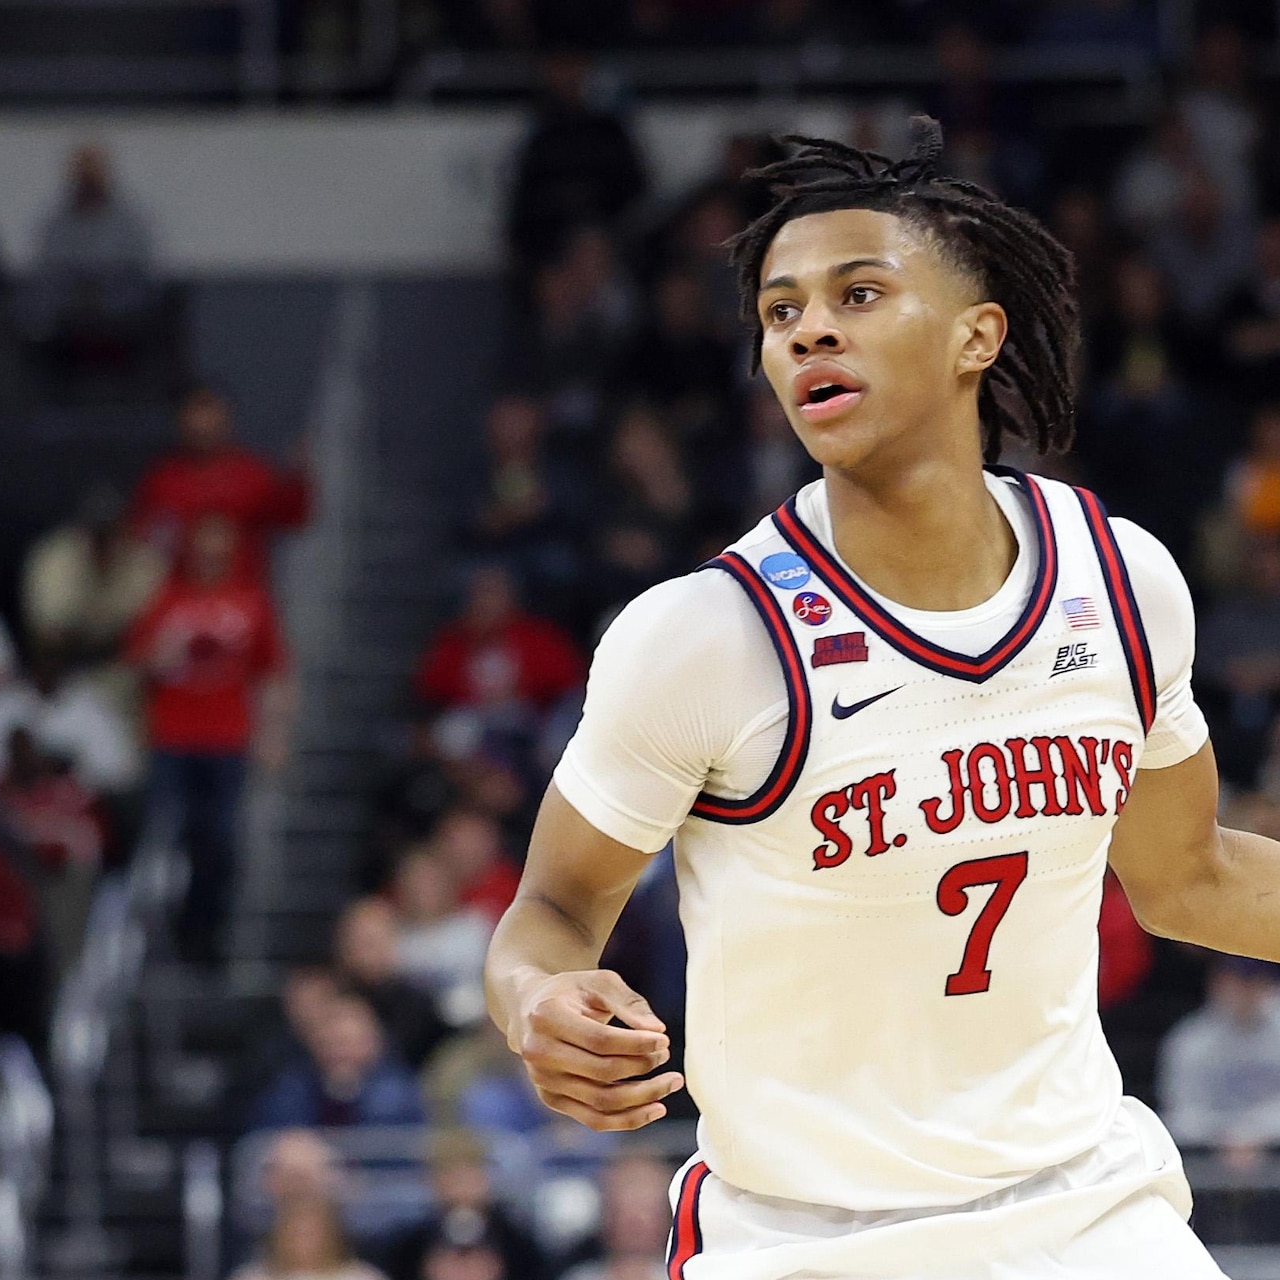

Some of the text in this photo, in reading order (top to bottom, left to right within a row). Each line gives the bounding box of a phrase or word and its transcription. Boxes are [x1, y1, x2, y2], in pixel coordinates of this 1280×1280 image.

[1051, 653, 1099, 672] EAST
[1056, 642, 1088, 660] BIG
[811, 735, 1134, 871] ST. JOHN'S
[936, 851, 1029, 997] 7
